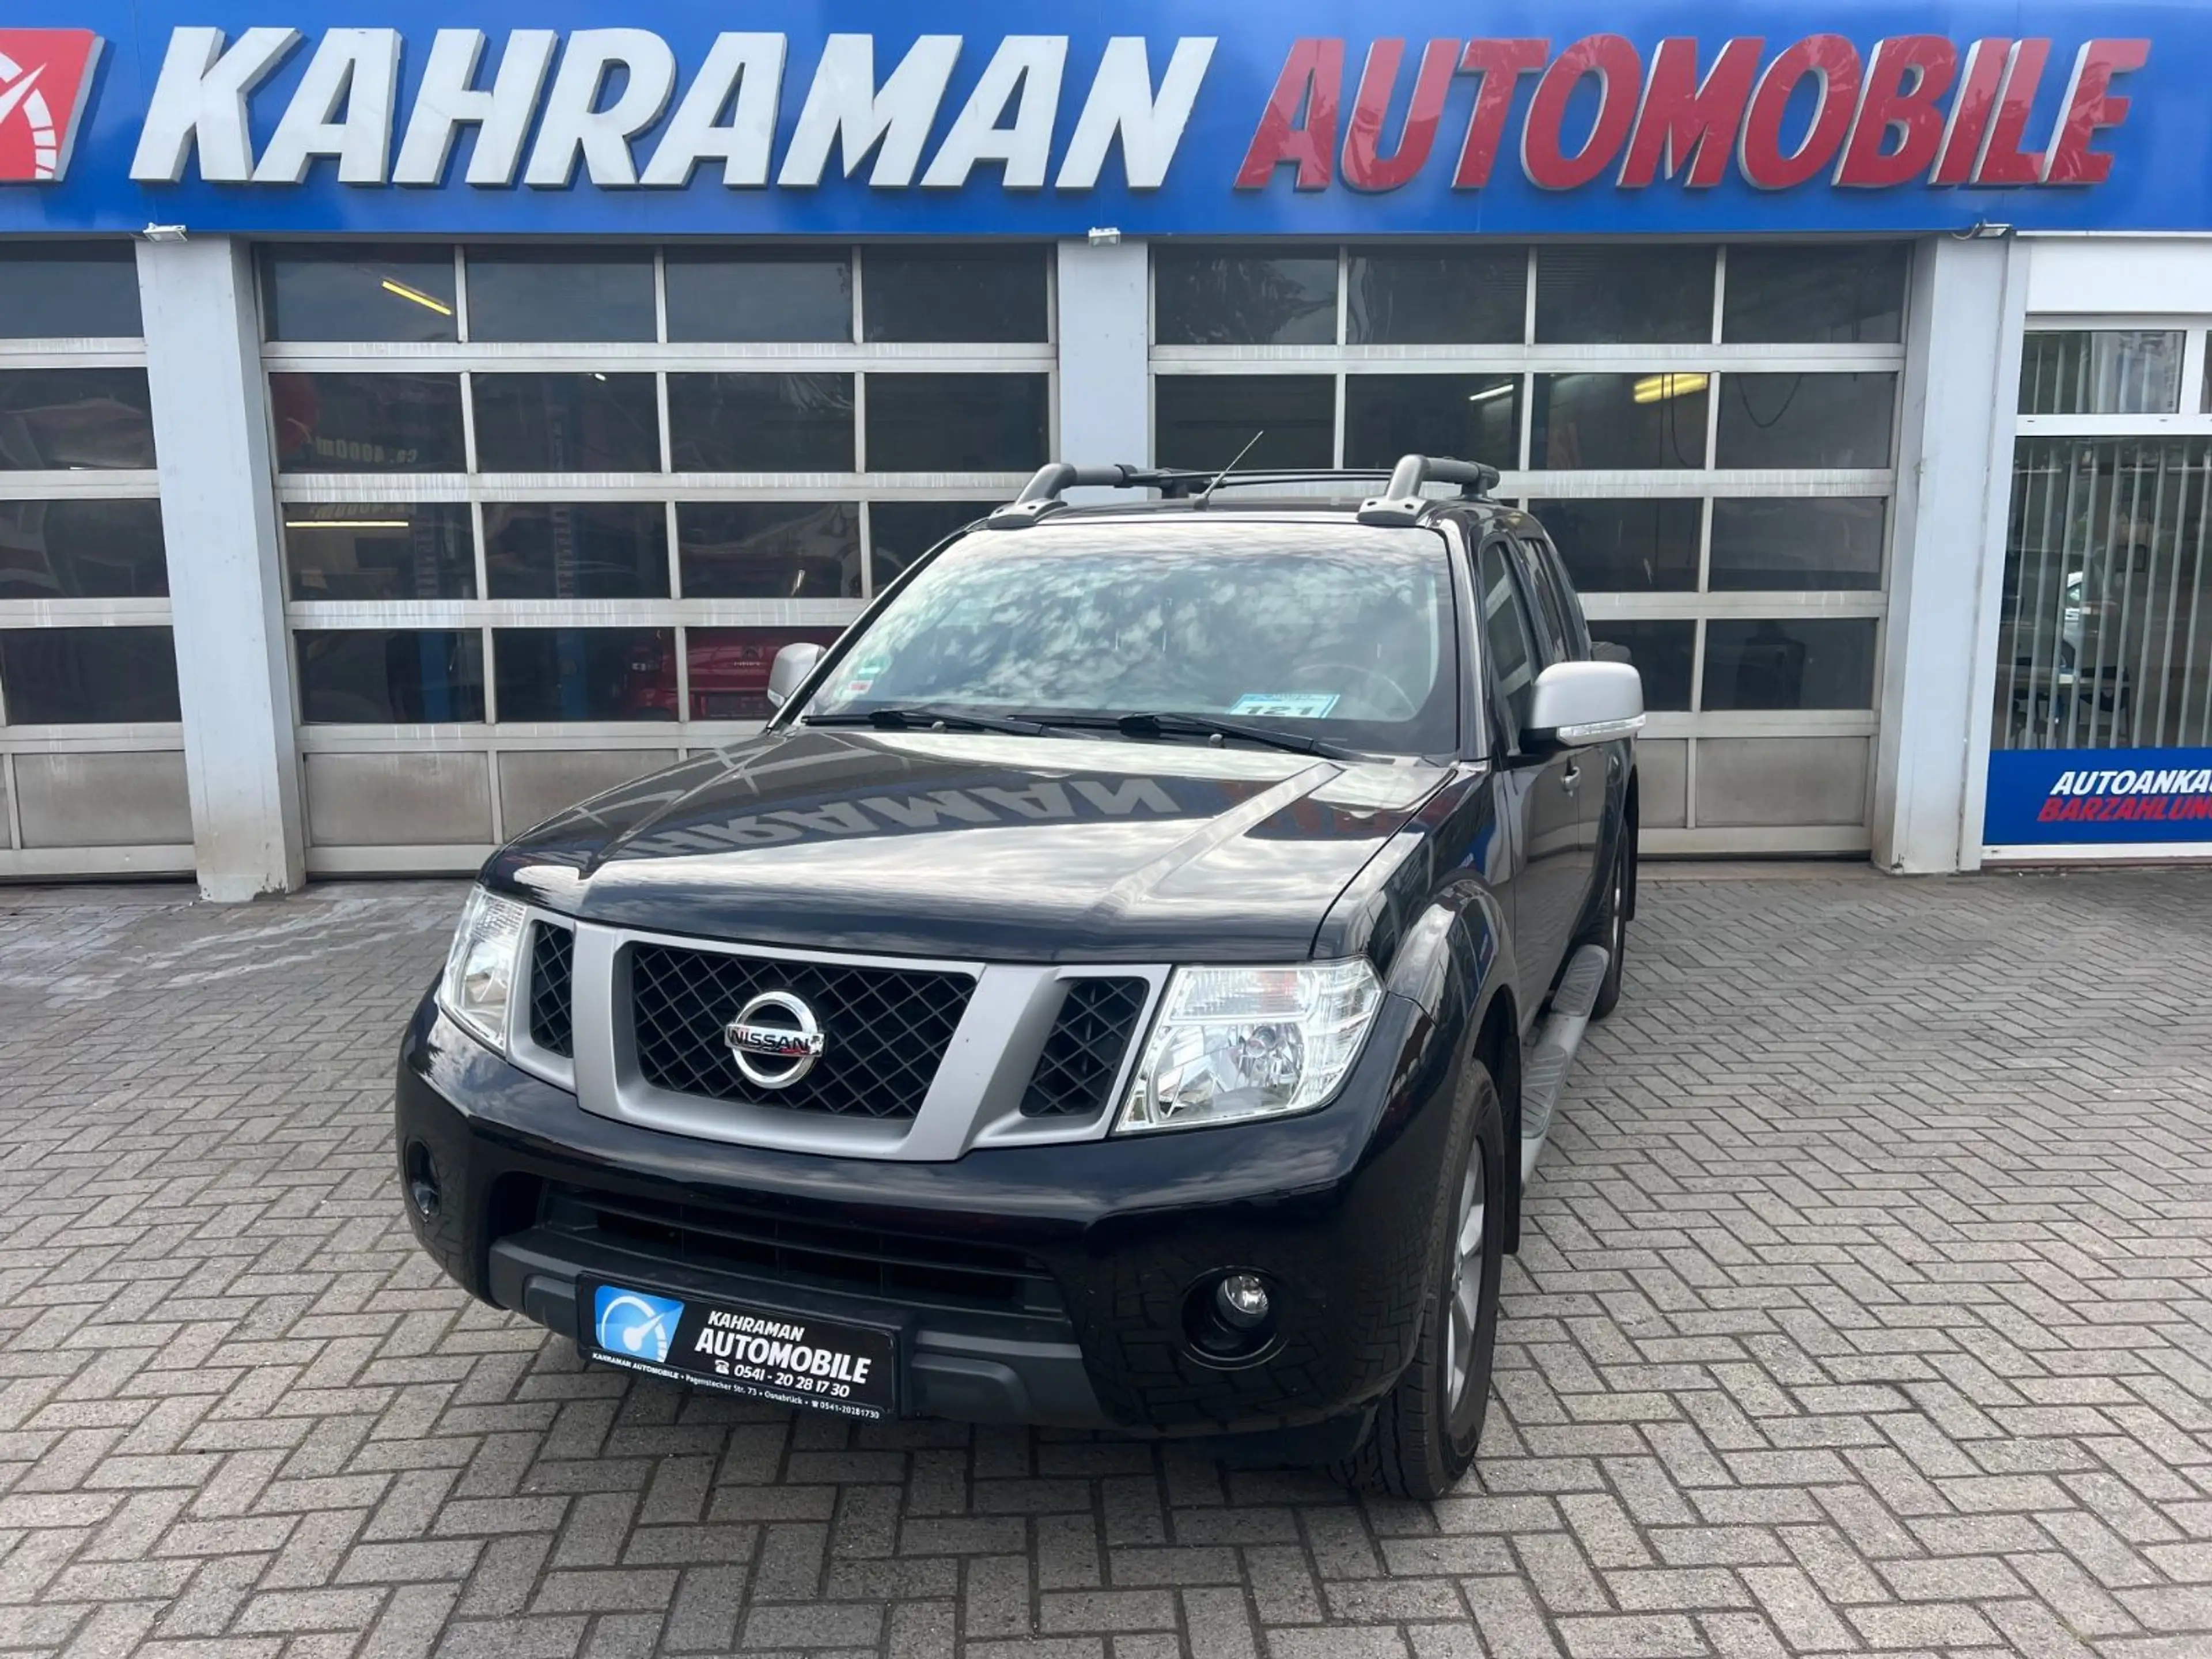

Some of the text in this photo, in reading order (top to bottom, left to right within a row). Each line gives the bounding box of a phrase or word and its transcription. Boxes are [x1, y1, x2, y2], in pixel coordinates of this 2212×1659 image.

[128, 26, 2151, 190] KAHRAMAN AUTOMOBILE
[2050, 769, 2212, 796] AUTOANKA
[2037, 796, 2212, 822] BARZAHLUN
[730, 1029, 809, 1052] NISSAN
[708, 1310, 805, 1342] KAHRAMAN
[592, 1353, 632, 1369] KAHRAMAN
[632, 1363, 680, 1380] AUTOMOBILE
[695, 1328, 871, 1384] AUTOMOBILE
[734, 1363, 765, 1381] 0541
[774, 1374, 793, 1387] 20
[795, 1377, 813, 1391] 28
[815, 1380, 830, 1393] 17
[831, 1384, 850, 1397] 30
